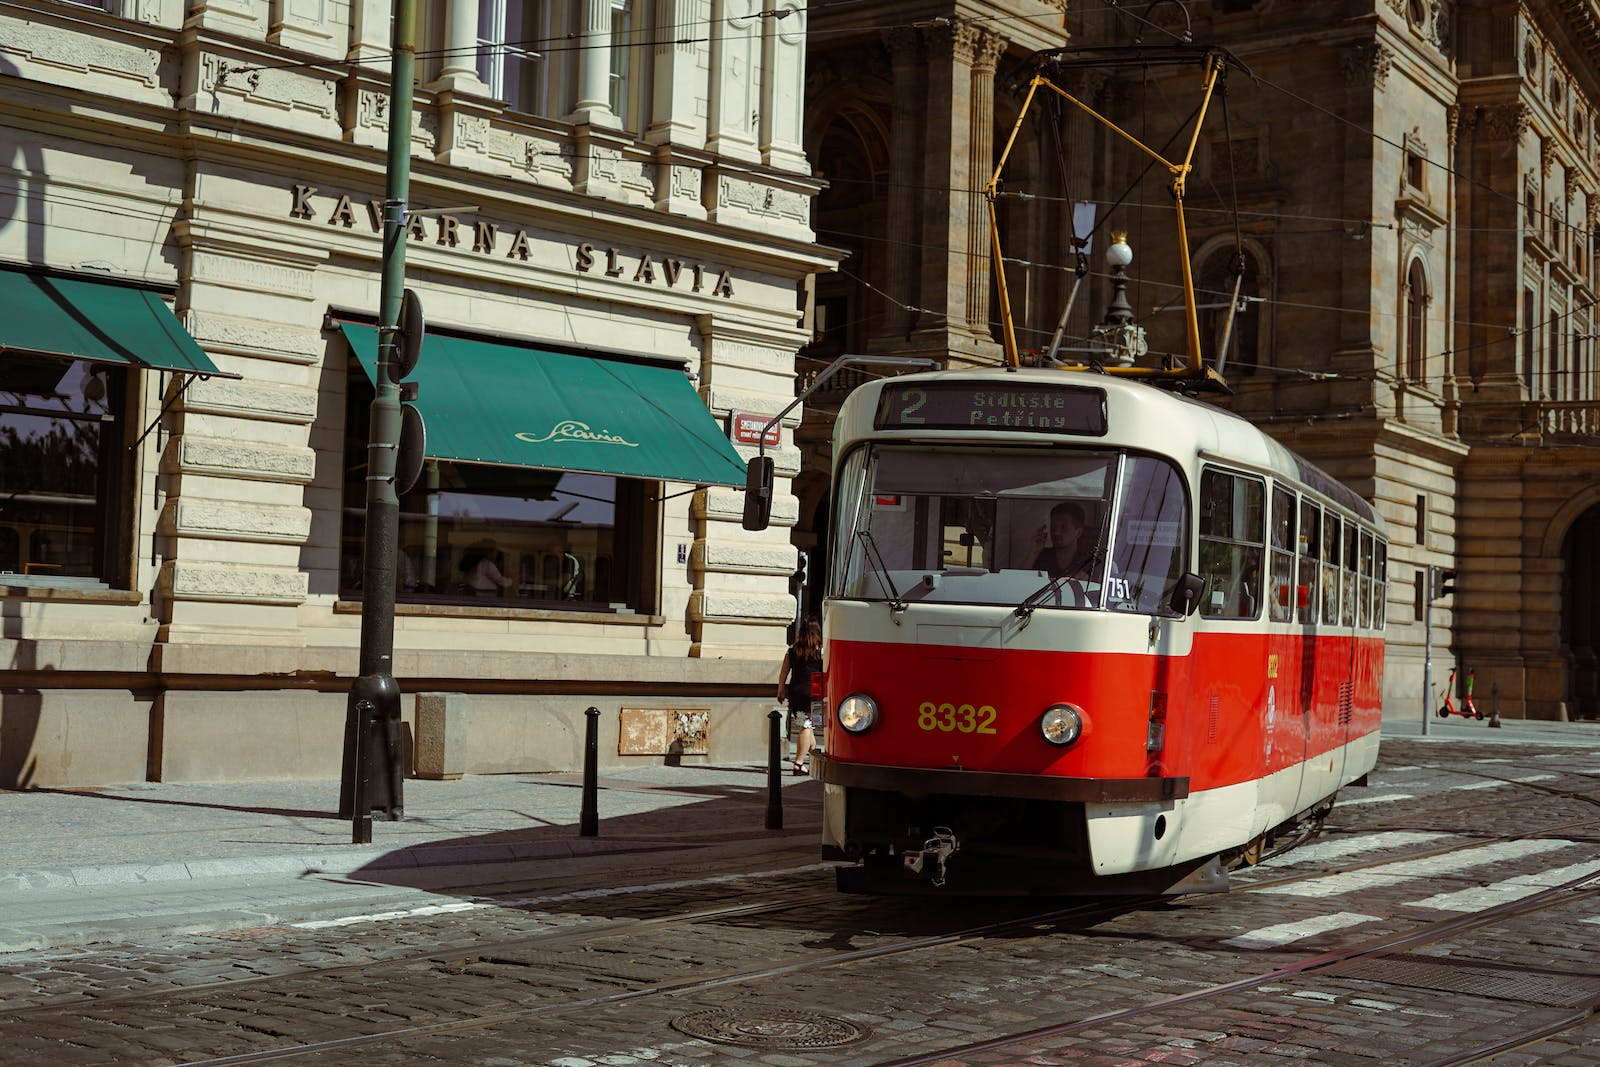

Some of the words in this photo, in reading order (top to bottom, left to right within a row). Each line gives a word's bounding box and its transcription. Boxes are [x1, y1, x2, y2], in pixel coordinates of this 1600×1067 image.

[575, 242, 735, 298] SLAVIA
[901, 388, 927, 425] 2
[514, 420, 639, 447] Slavia
[1109, 577, 1130, 600] 751
[917, 702, 997, 735] 8332
